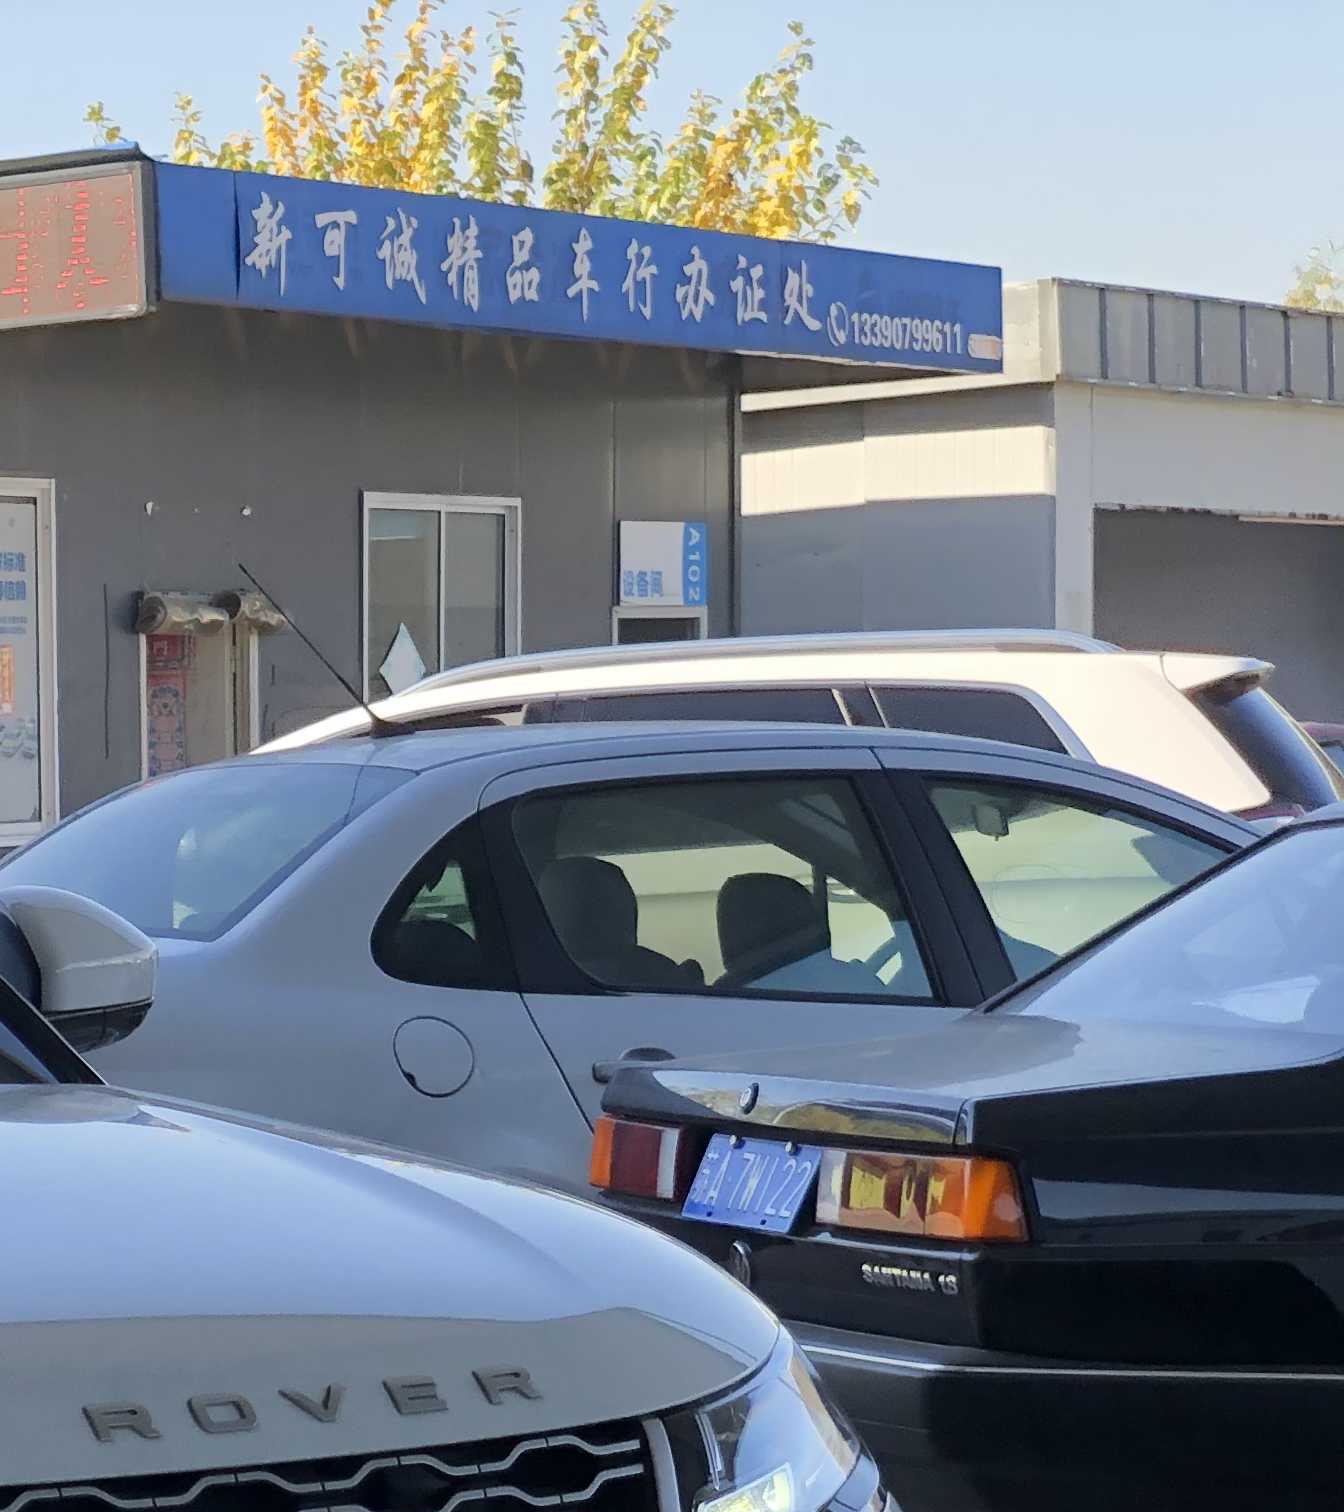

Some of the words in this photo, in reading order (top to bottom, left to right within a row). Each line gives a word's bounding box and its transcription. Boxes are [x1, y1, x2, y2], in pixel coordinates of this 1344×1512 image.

[244, 191, 822, 331] 新可诚精品车行办证处
[850, 311, 962, 354] 13390799611
[687, 527, 701, 601] A102
[80, 1366, 544, 1443] ROVER
